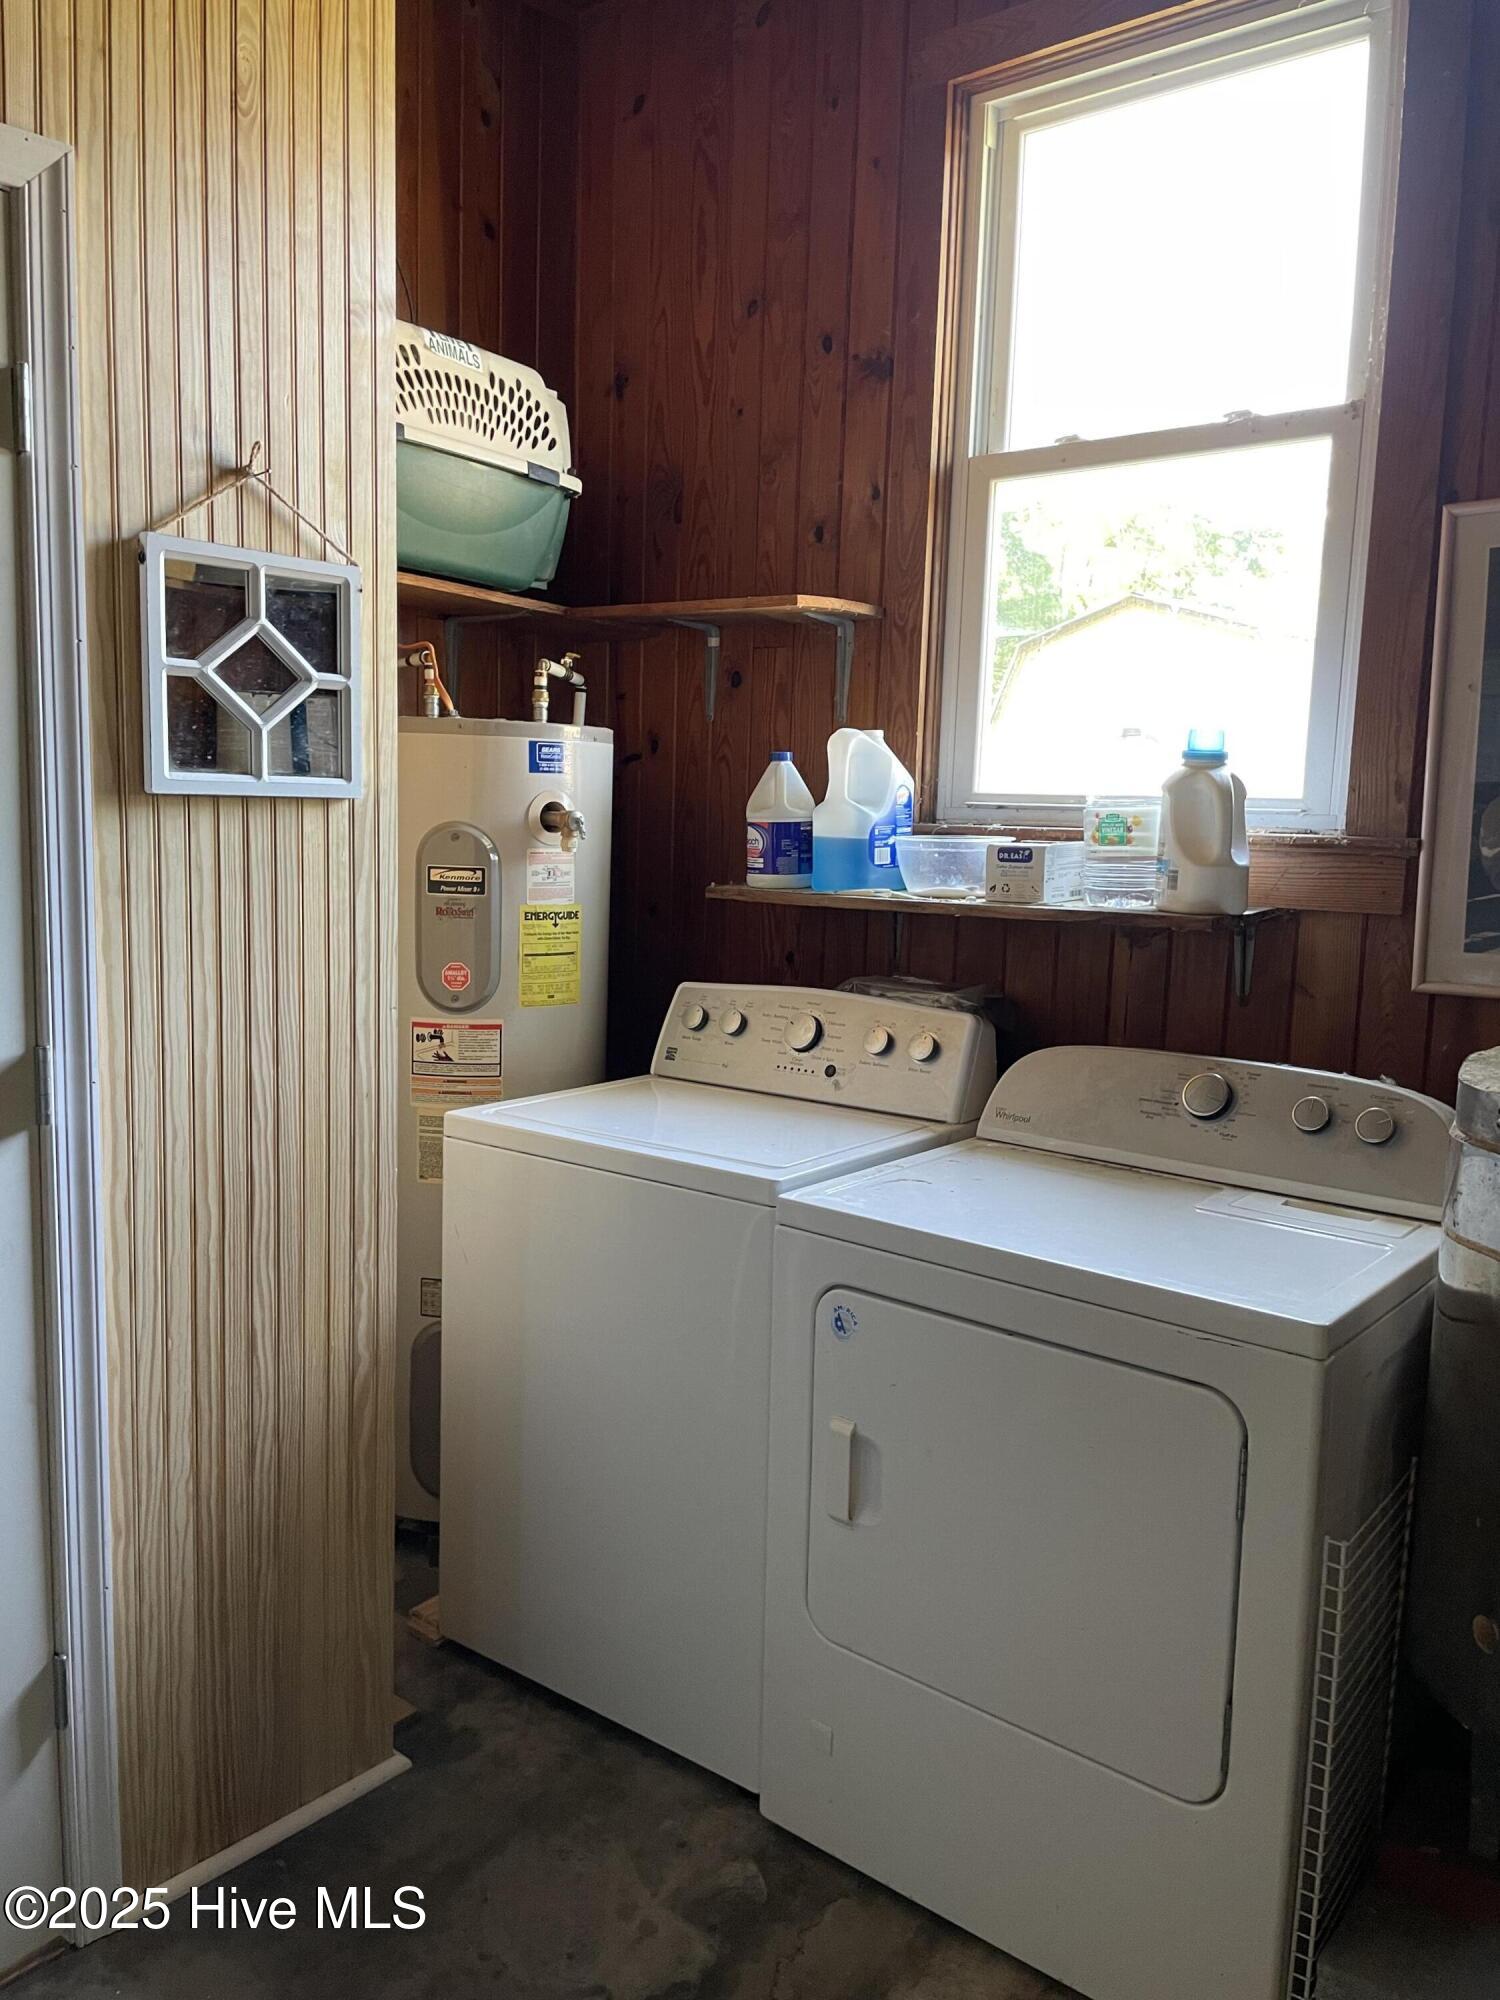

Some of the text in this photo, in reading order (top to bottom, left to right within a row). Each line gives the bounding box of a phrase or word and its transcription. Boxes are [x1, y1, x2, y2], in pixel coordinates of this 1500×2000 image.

[428, 337, 481, 369] ANIMALS
[439, 873, 481, 881] Kenmore
[524, 910, 580, 921] ENERGYGUIDE
[996, 1110, 1031, 1123] Whirlpool
